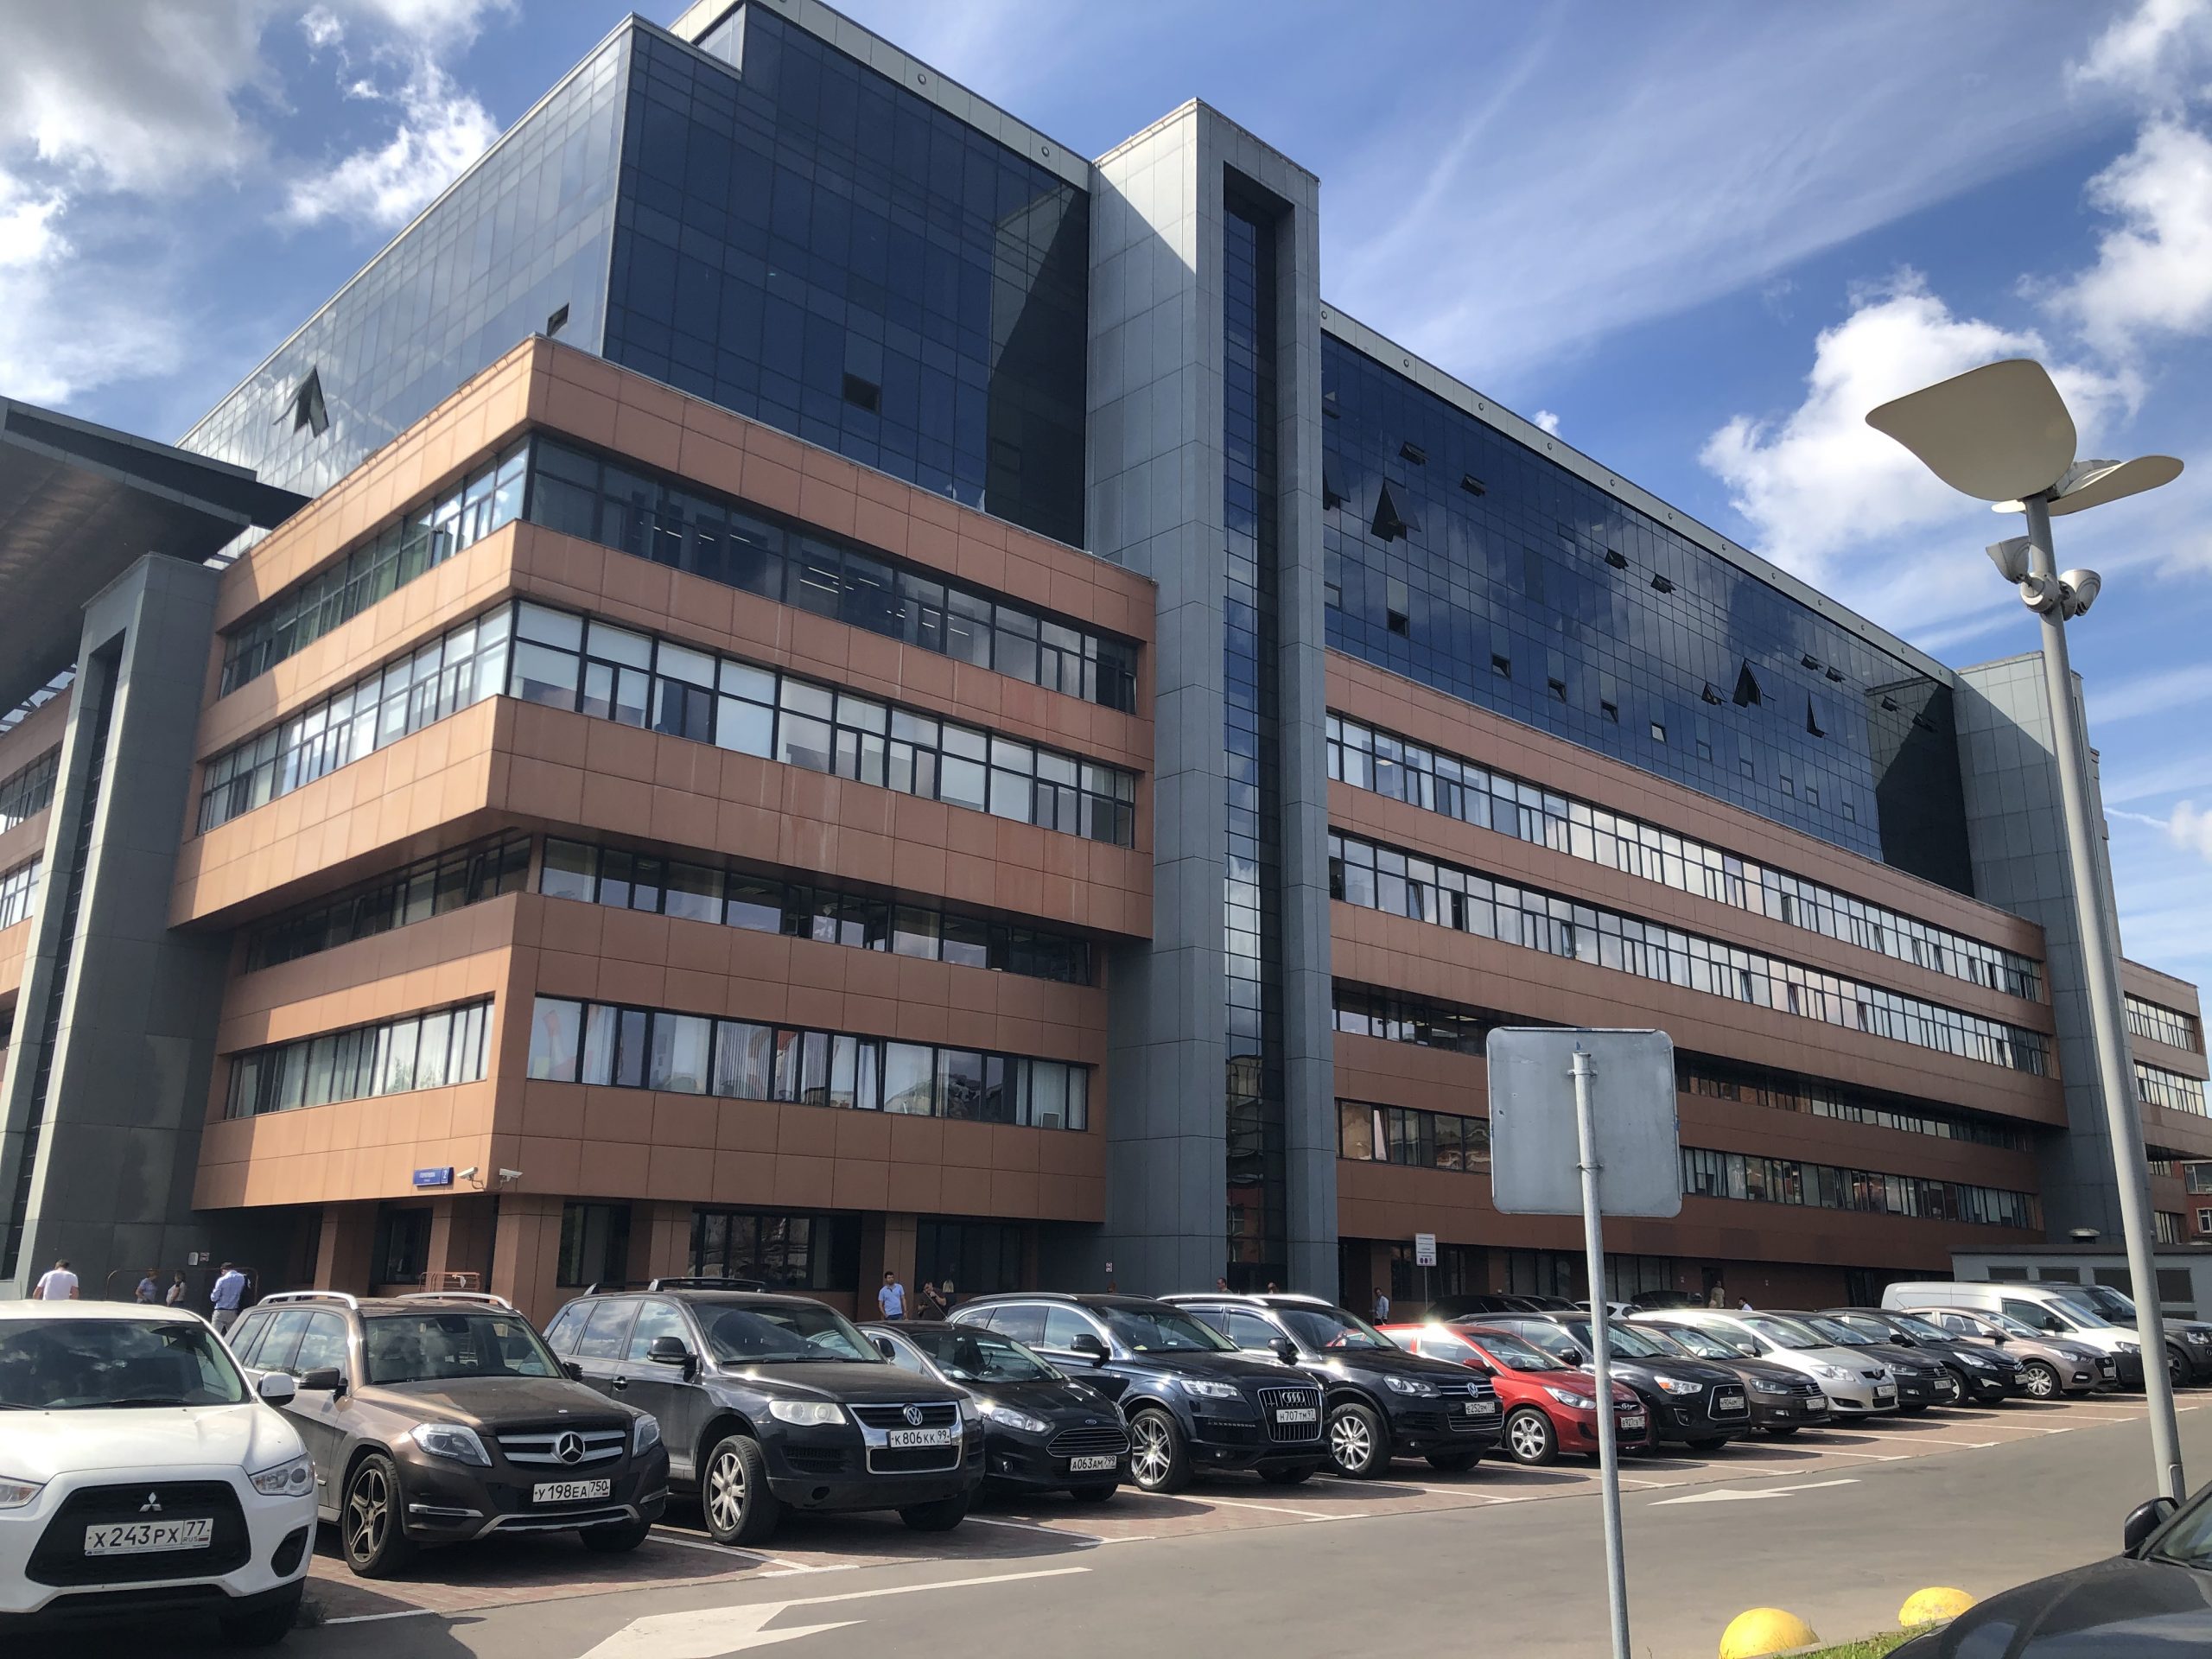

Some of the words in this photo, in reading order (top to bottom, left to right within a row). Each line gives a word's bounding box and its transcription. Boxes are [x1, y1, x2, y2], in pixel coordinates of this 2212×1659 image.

[894, 1432, 936, 1446] К806КК
[938, 1430, 947, 1440] 99
[1072, 1458, 1103, 1470] А063АМ
[538, 1484, 588, 1500] У198ЕА
[590, 1480, 607, 1493] 750
[92, 1525, 180, 1548] Х243РХ
[187, 1520, 207, 1536] 77
